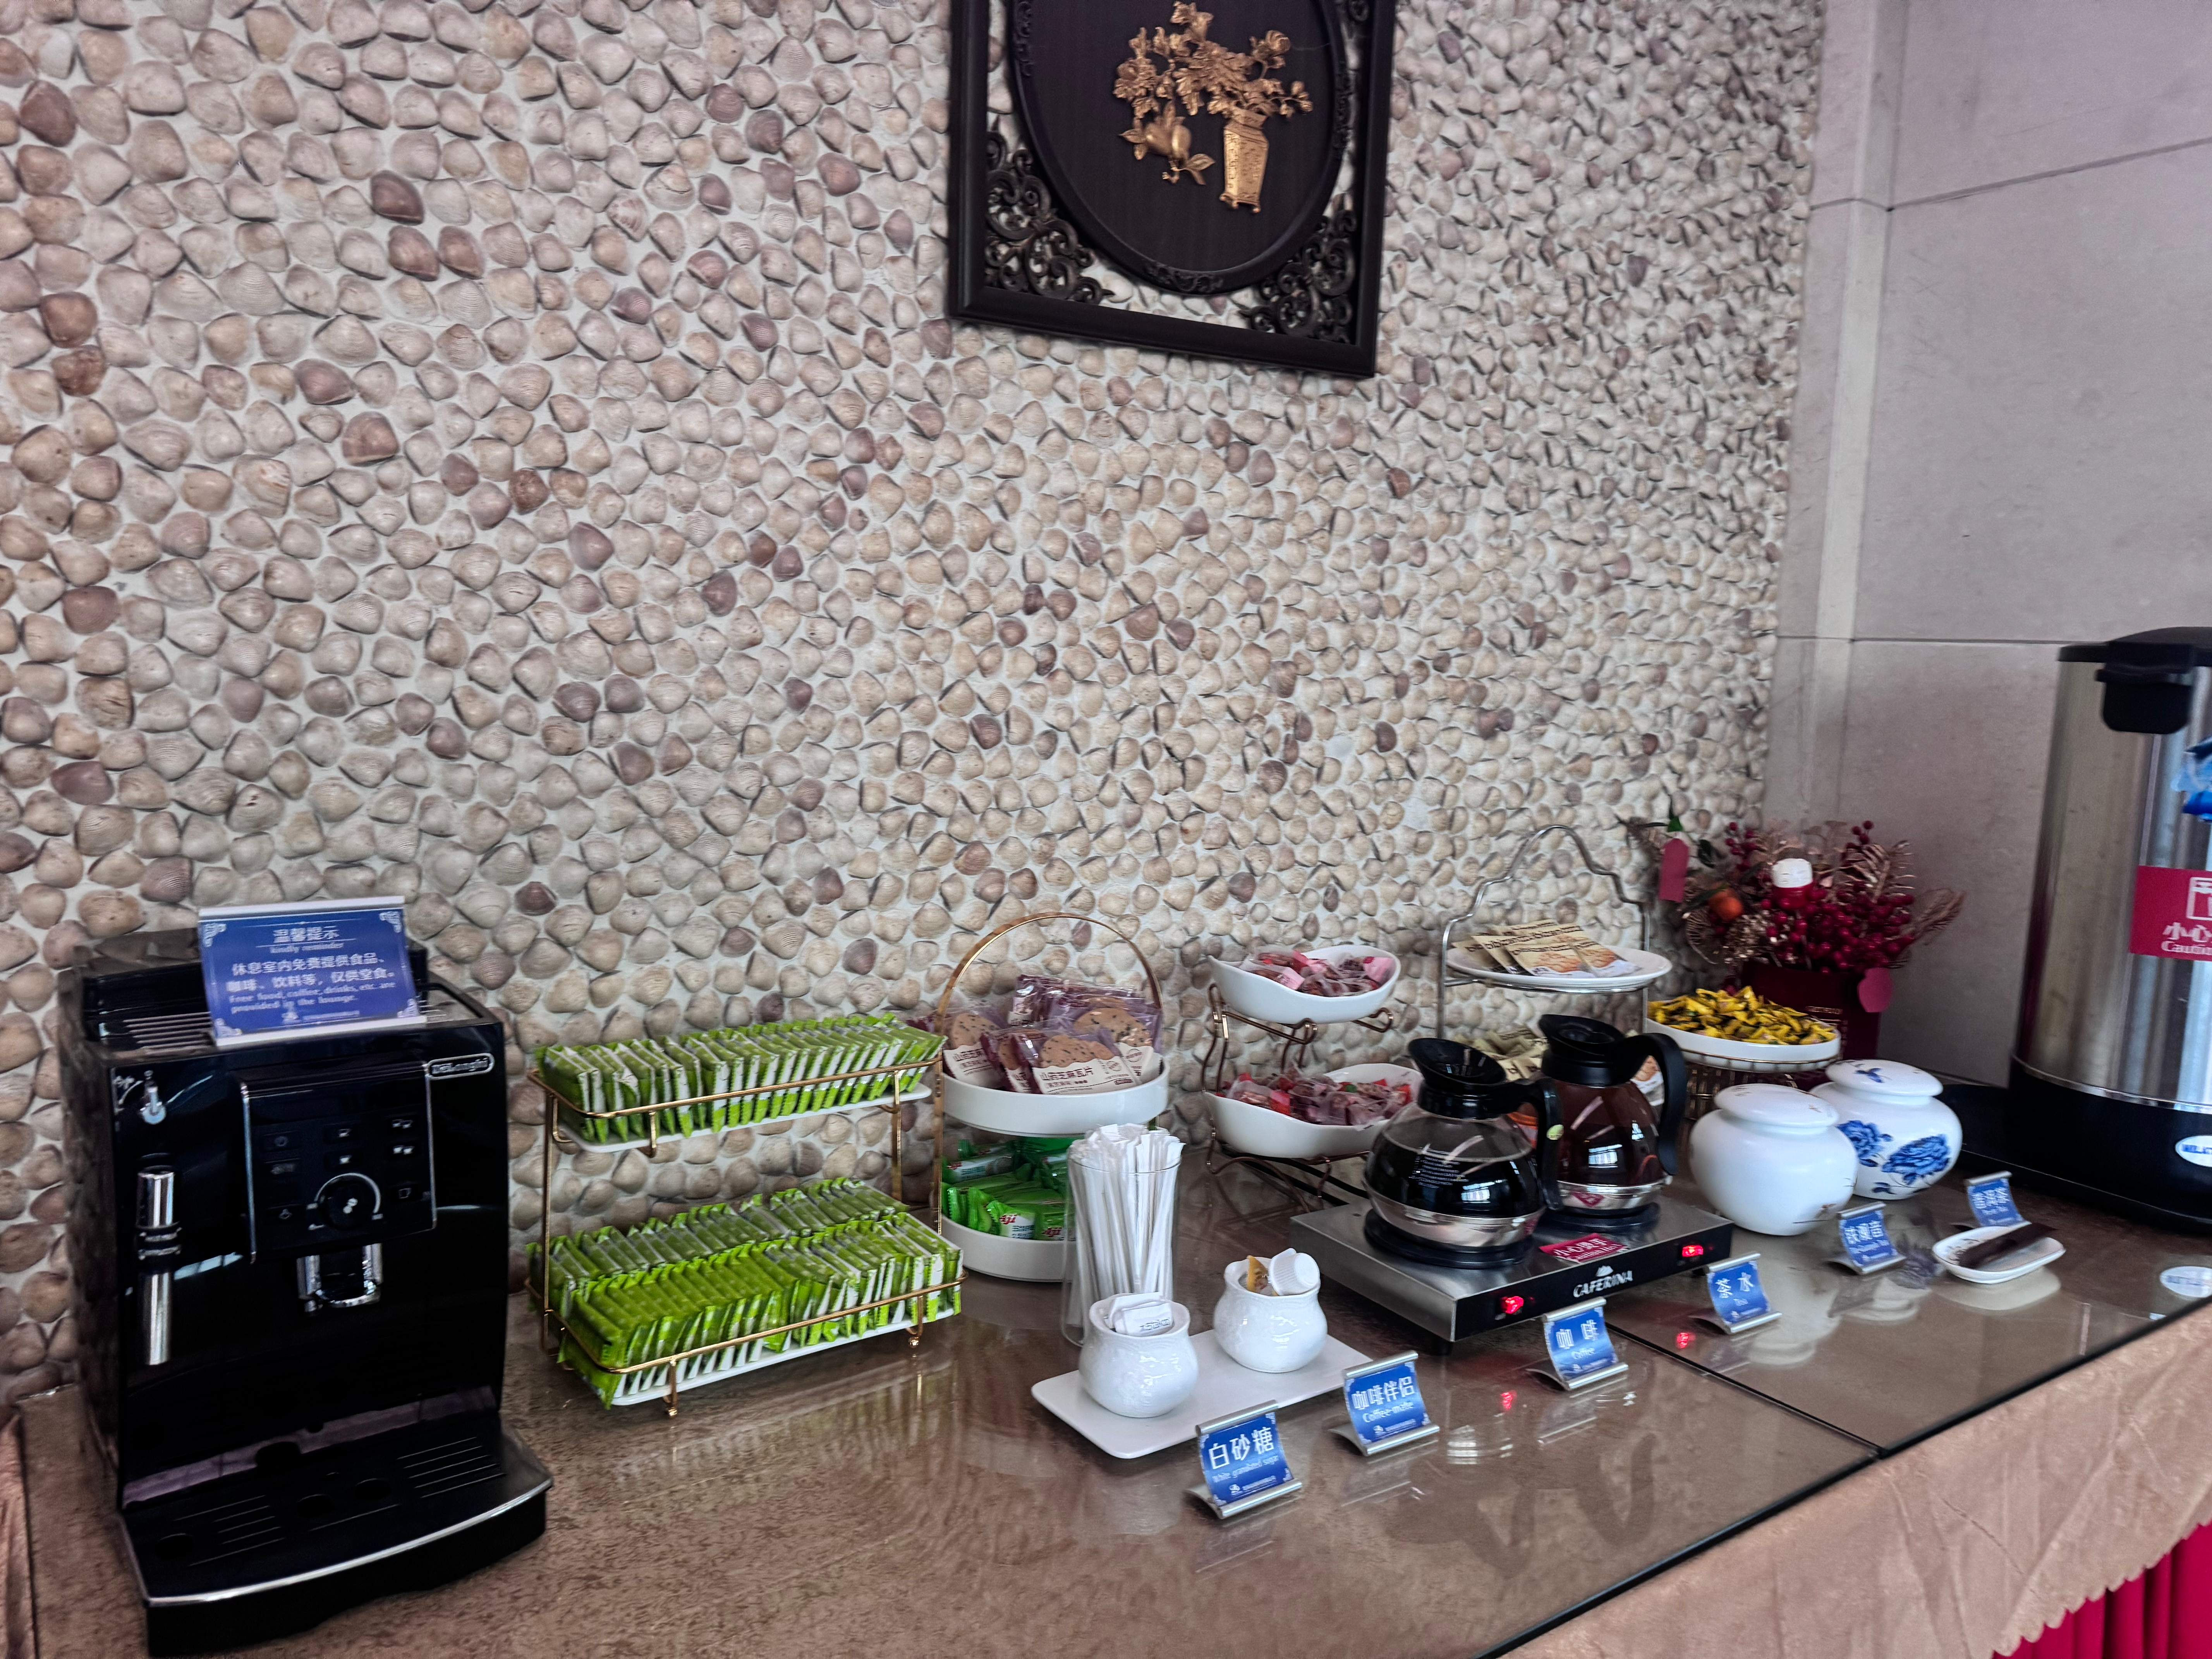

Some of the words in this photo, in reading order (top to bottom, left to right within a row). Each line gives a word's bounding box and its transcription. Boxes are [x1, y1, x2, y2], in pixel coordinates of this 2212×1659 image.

[273, 926, 340, 943] 温馨提示
[1715, 1272, 1754, 1298] 茶水
[1556, 1319, 1600, 1349] 咖啡
[1352, 1376, 1415, 1410] 咖啡伴侣
[1209, 1427, 1274, 1469] 白砂糖
